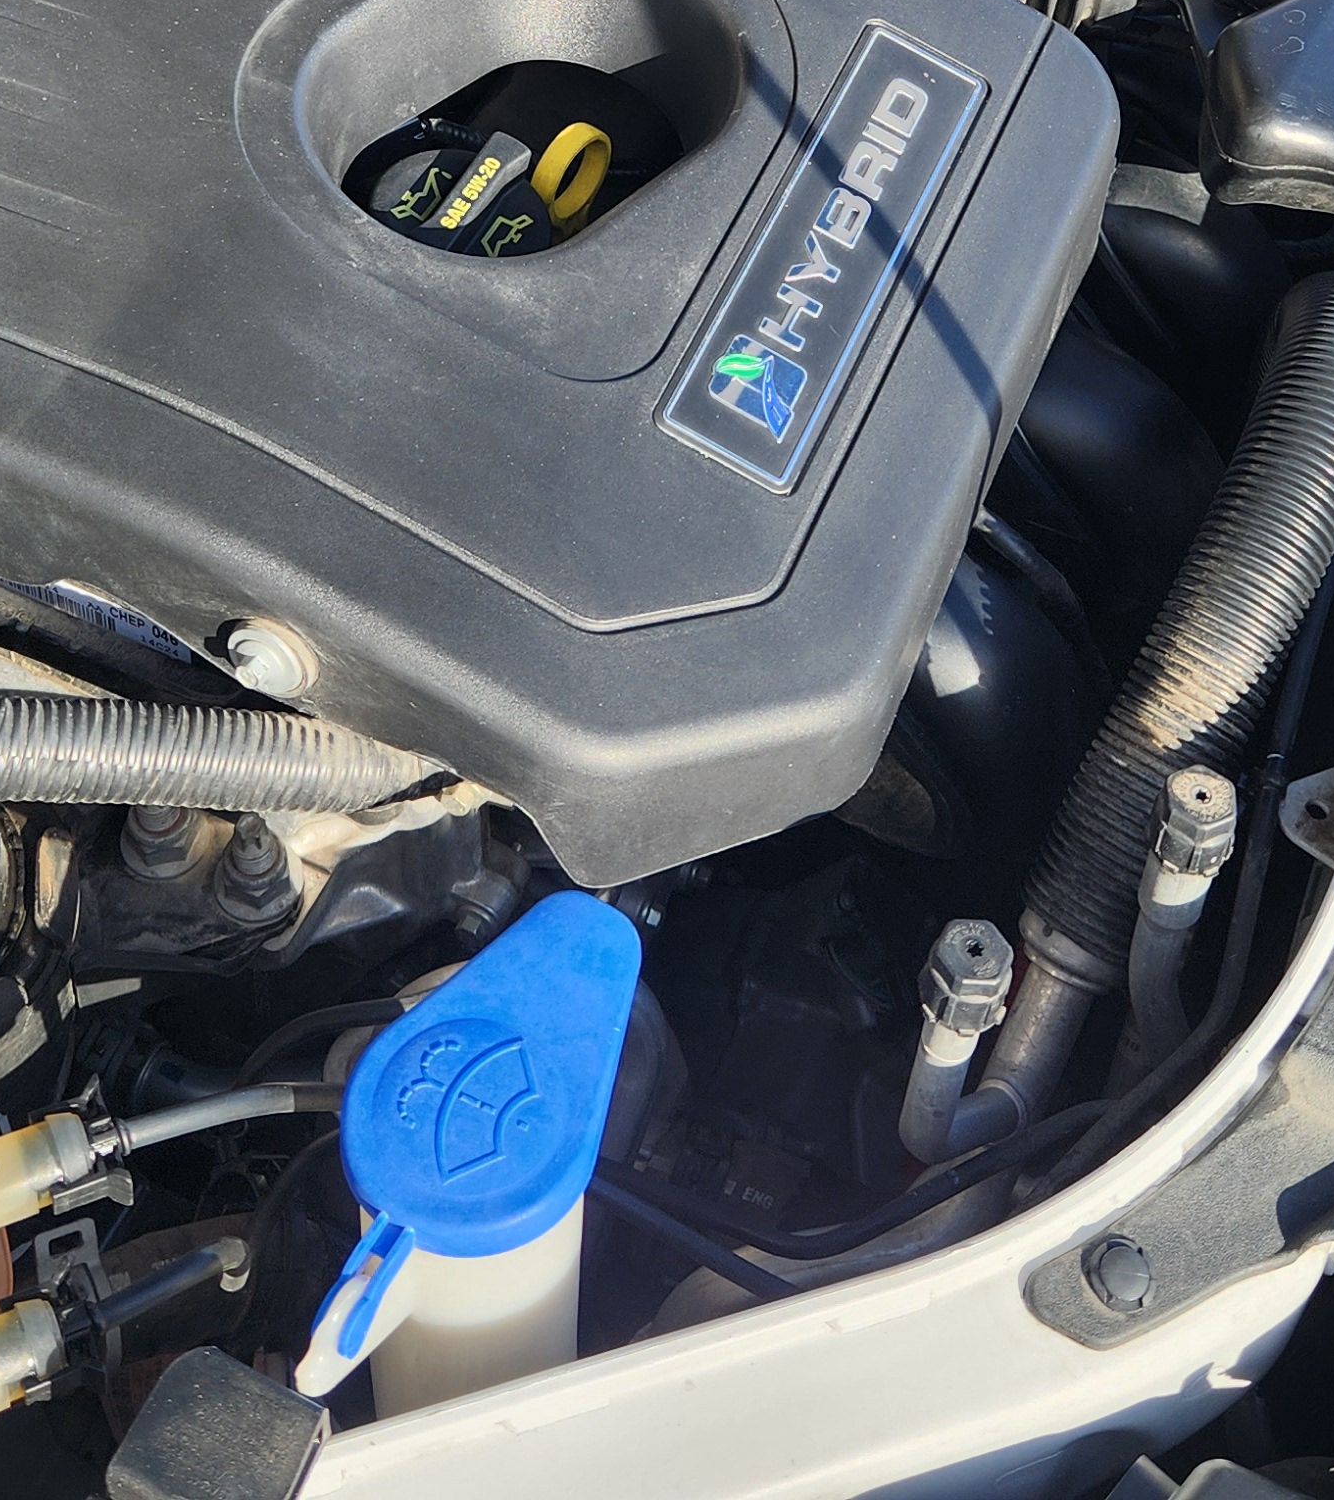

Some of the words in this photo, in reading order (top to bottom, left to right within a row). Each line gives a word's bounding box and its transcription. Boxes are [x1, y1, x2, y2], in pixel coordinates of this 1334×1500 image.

[440, 197, 471, 229] SAE
[462, 157, 501, 201] 5W-20
[759, 77, 929, 352] HYBRID
[109, 606, 145, 629] CHEP
[141, 634, 180, 658] 14C24
[742, 1186, 774, 1210] ENG
